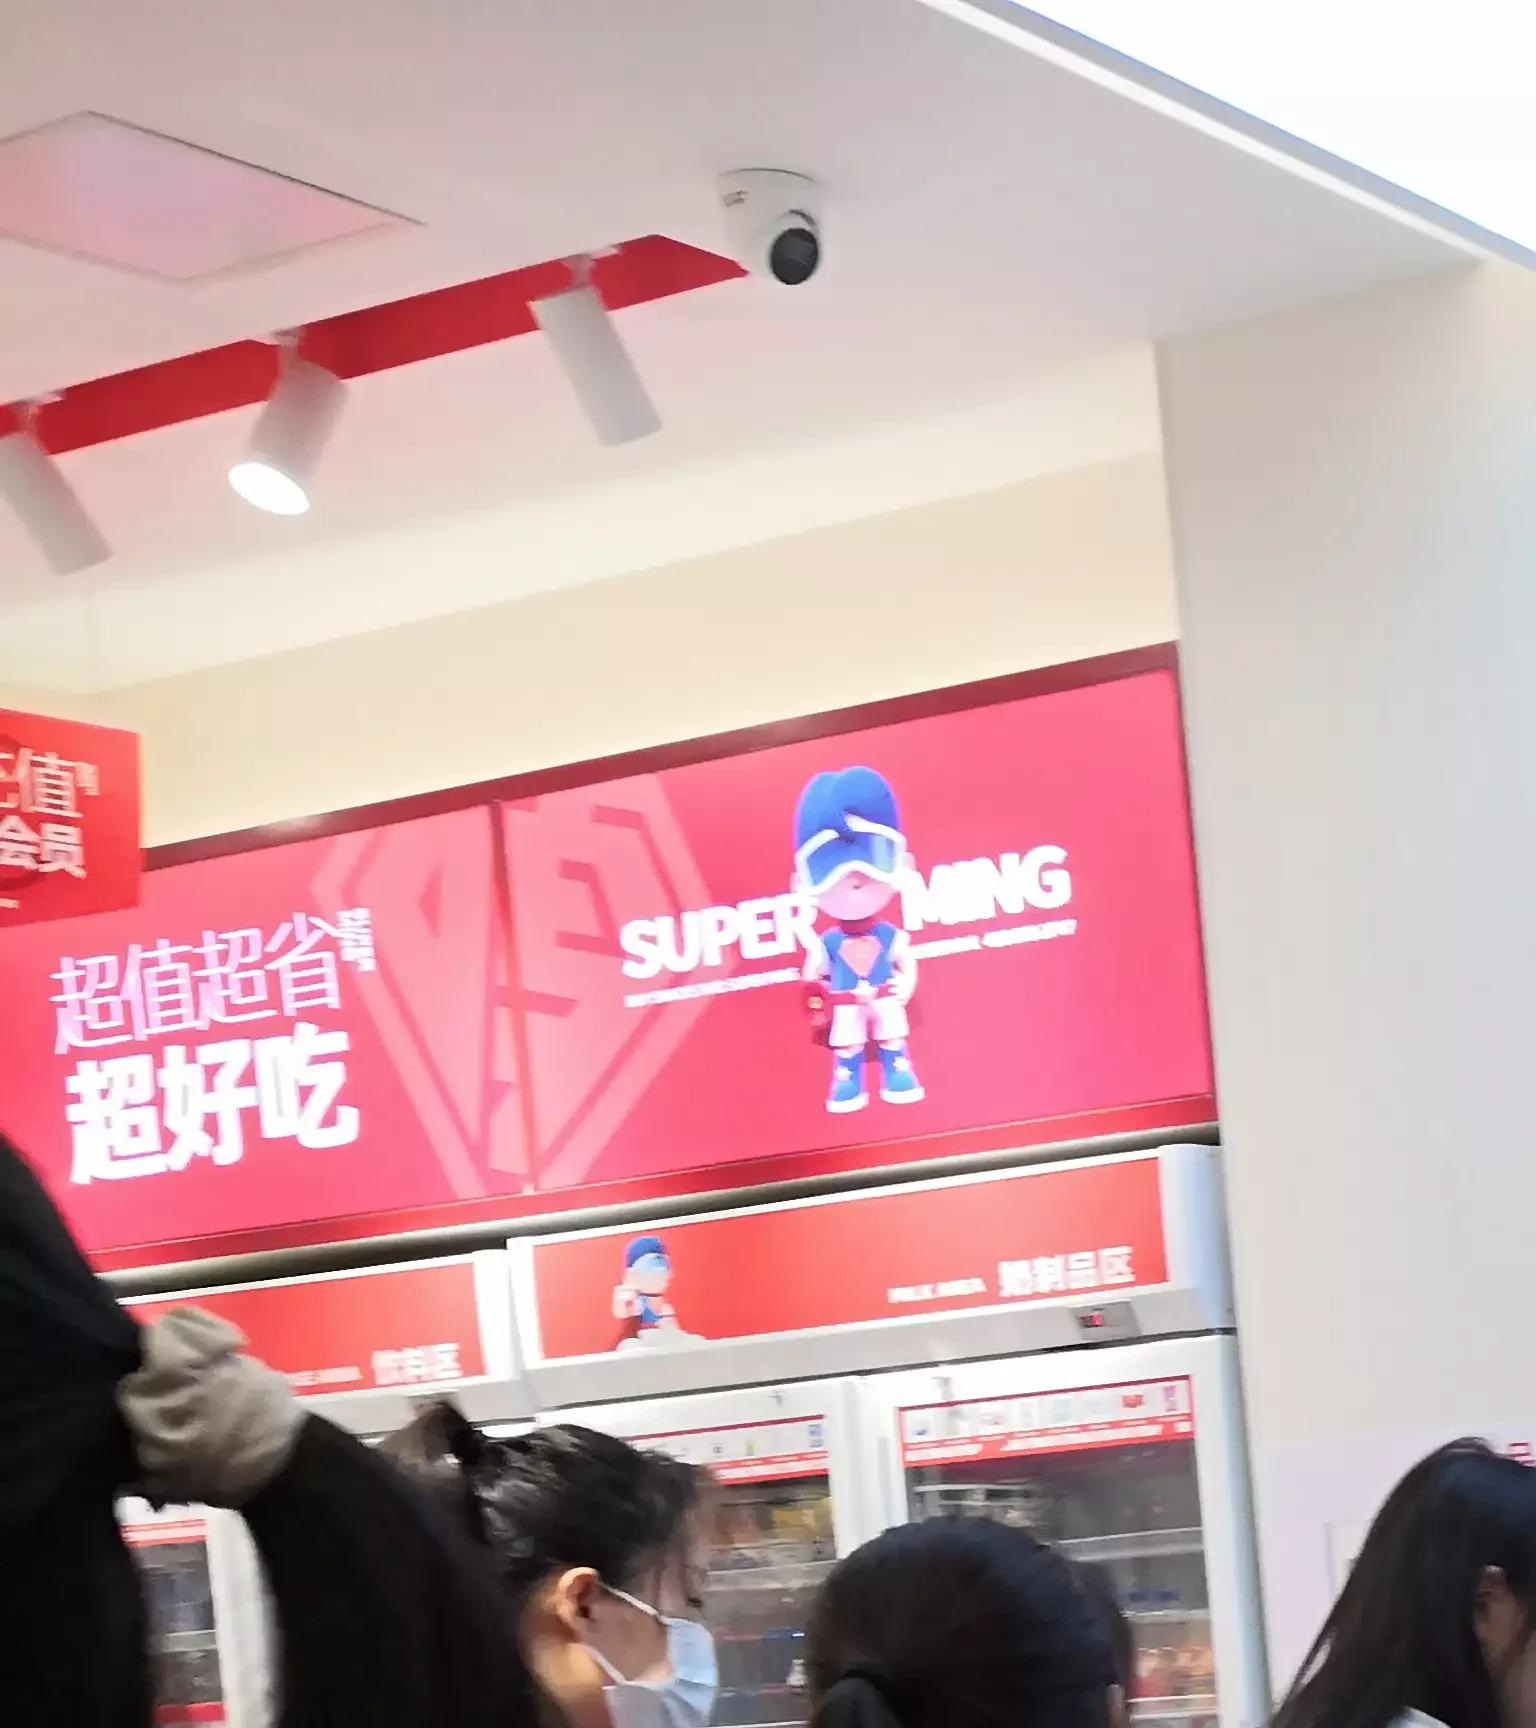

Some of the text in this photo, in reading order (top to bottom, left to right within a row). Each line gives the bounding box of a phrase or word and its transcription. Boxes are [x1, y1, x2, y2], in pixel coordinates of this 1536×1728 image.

[50, 912, 341, 1054] 超值超省
[620, 892, 819, 979] SUPER
[901, 845, 1072, 931] MING
[65, 1022, 360, 1184] 超好吃
